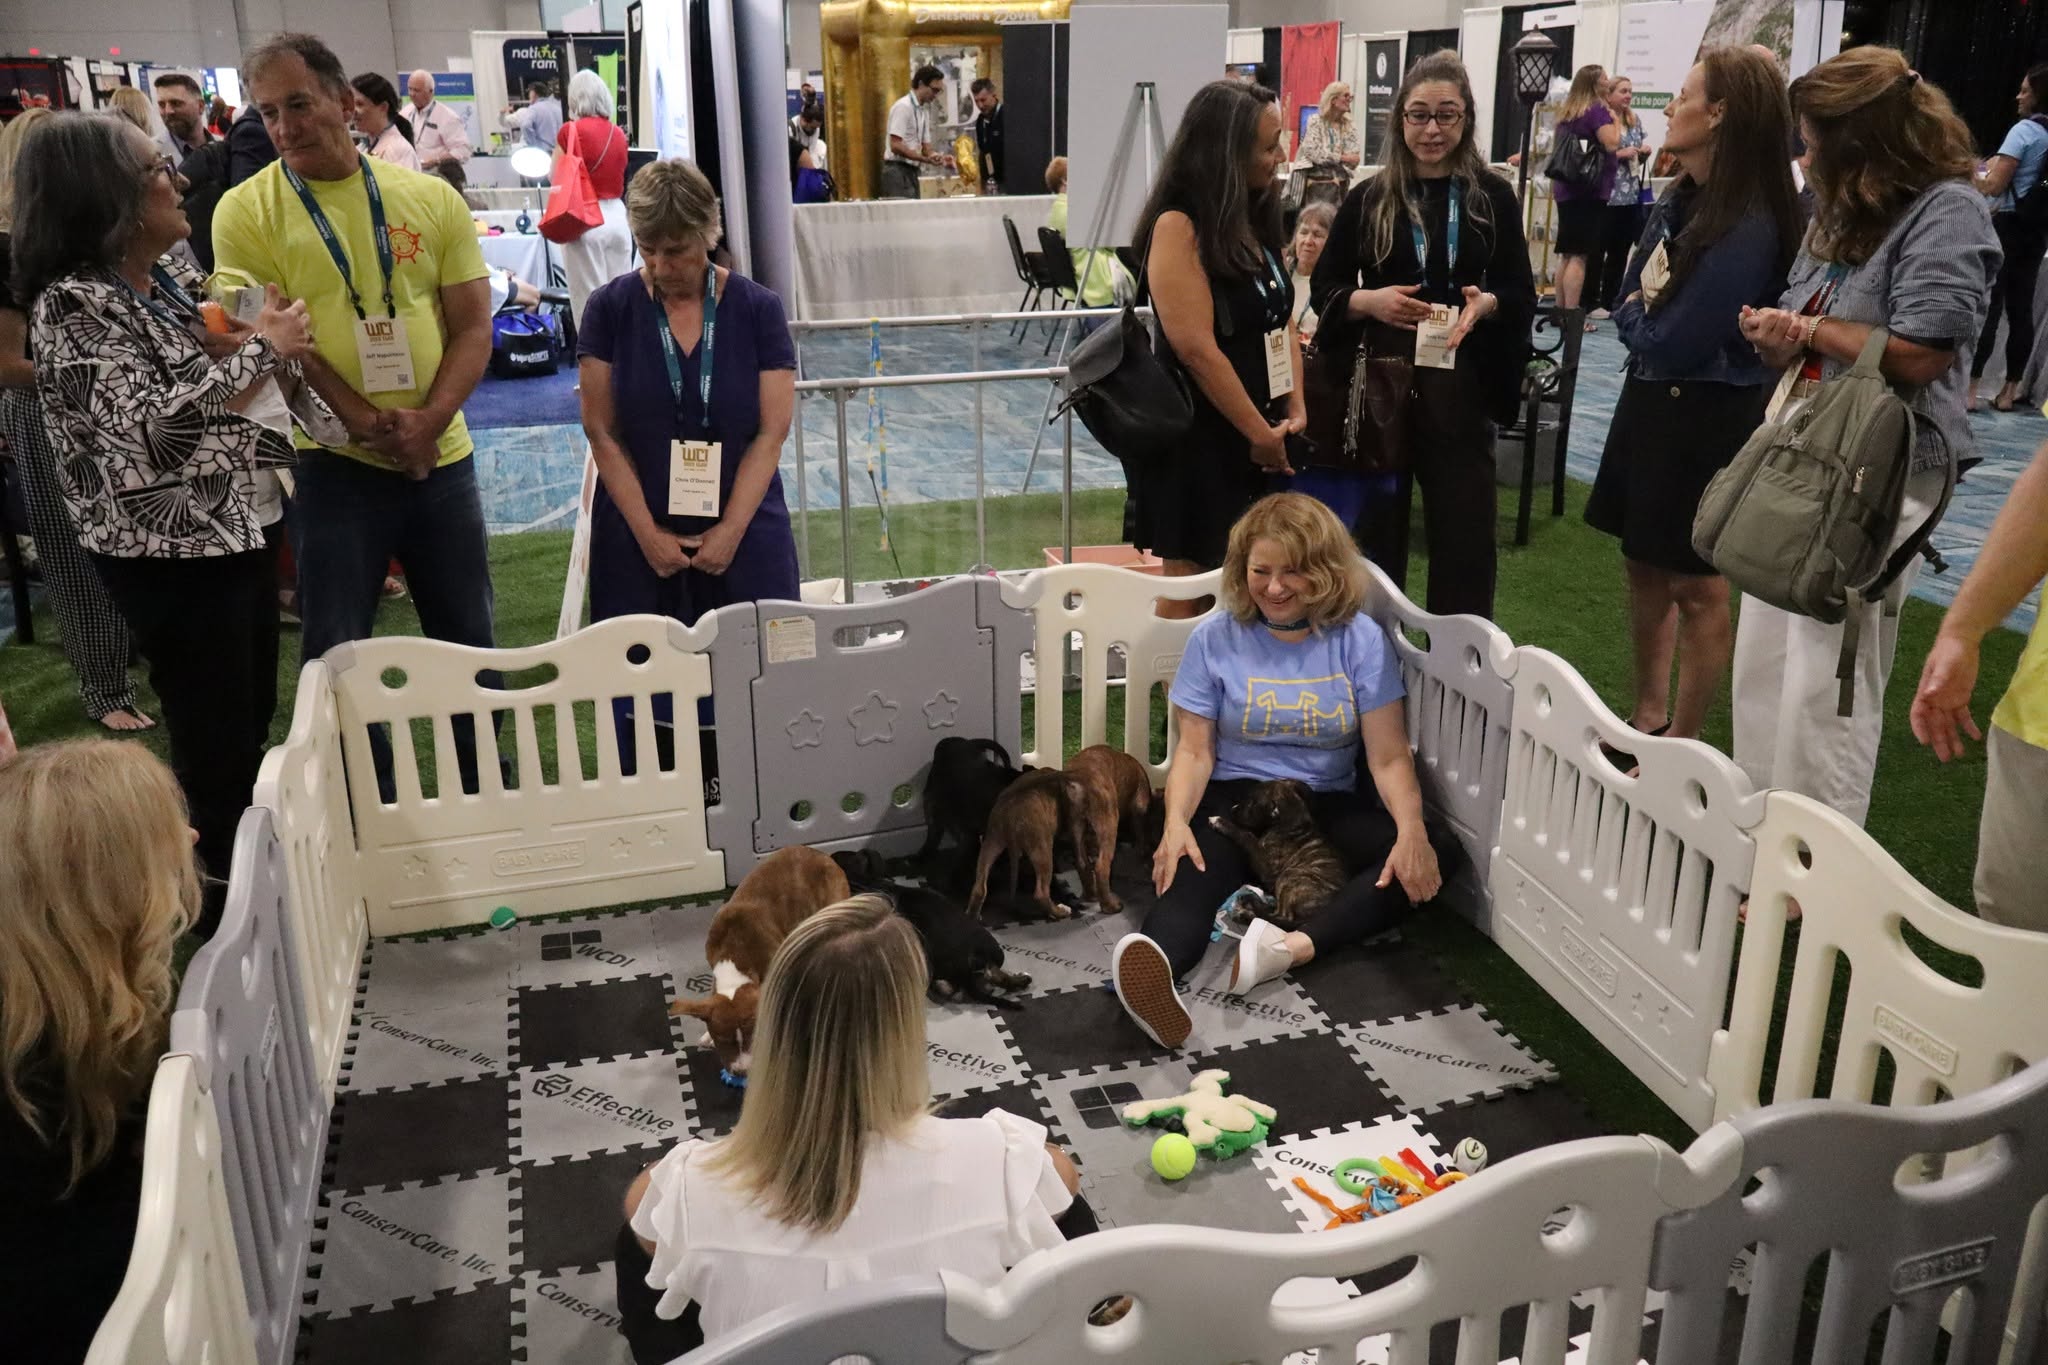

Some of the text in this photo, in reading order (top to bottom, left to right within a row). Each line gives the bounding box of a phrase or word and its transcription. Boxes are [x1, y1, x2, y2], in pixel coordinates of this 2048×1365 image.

[576, 944, 636, 968] WCDI
[1001, 943, 1077, 969] servCare,
[1191, 997, 1301, 1028] HEALTH SYSTEMS
[1196, 986, 1306, 1022] Effective
[469, 1052, 499, 1069] Inc.
[927, 1042, 1007, 1074] fective
[945, 1061, 1000, 1080] SYSTEMS
[1499, 1064, 1535, 1076] Inc.
[562, 1099, 664, 1137] HEALTH SYSTEMS
[570, 1086, 674, 1130] Effective
[340, 1200, 496, 1275] ConservCare, Inc.
[537, 1282, 623, 1328] Conserv
